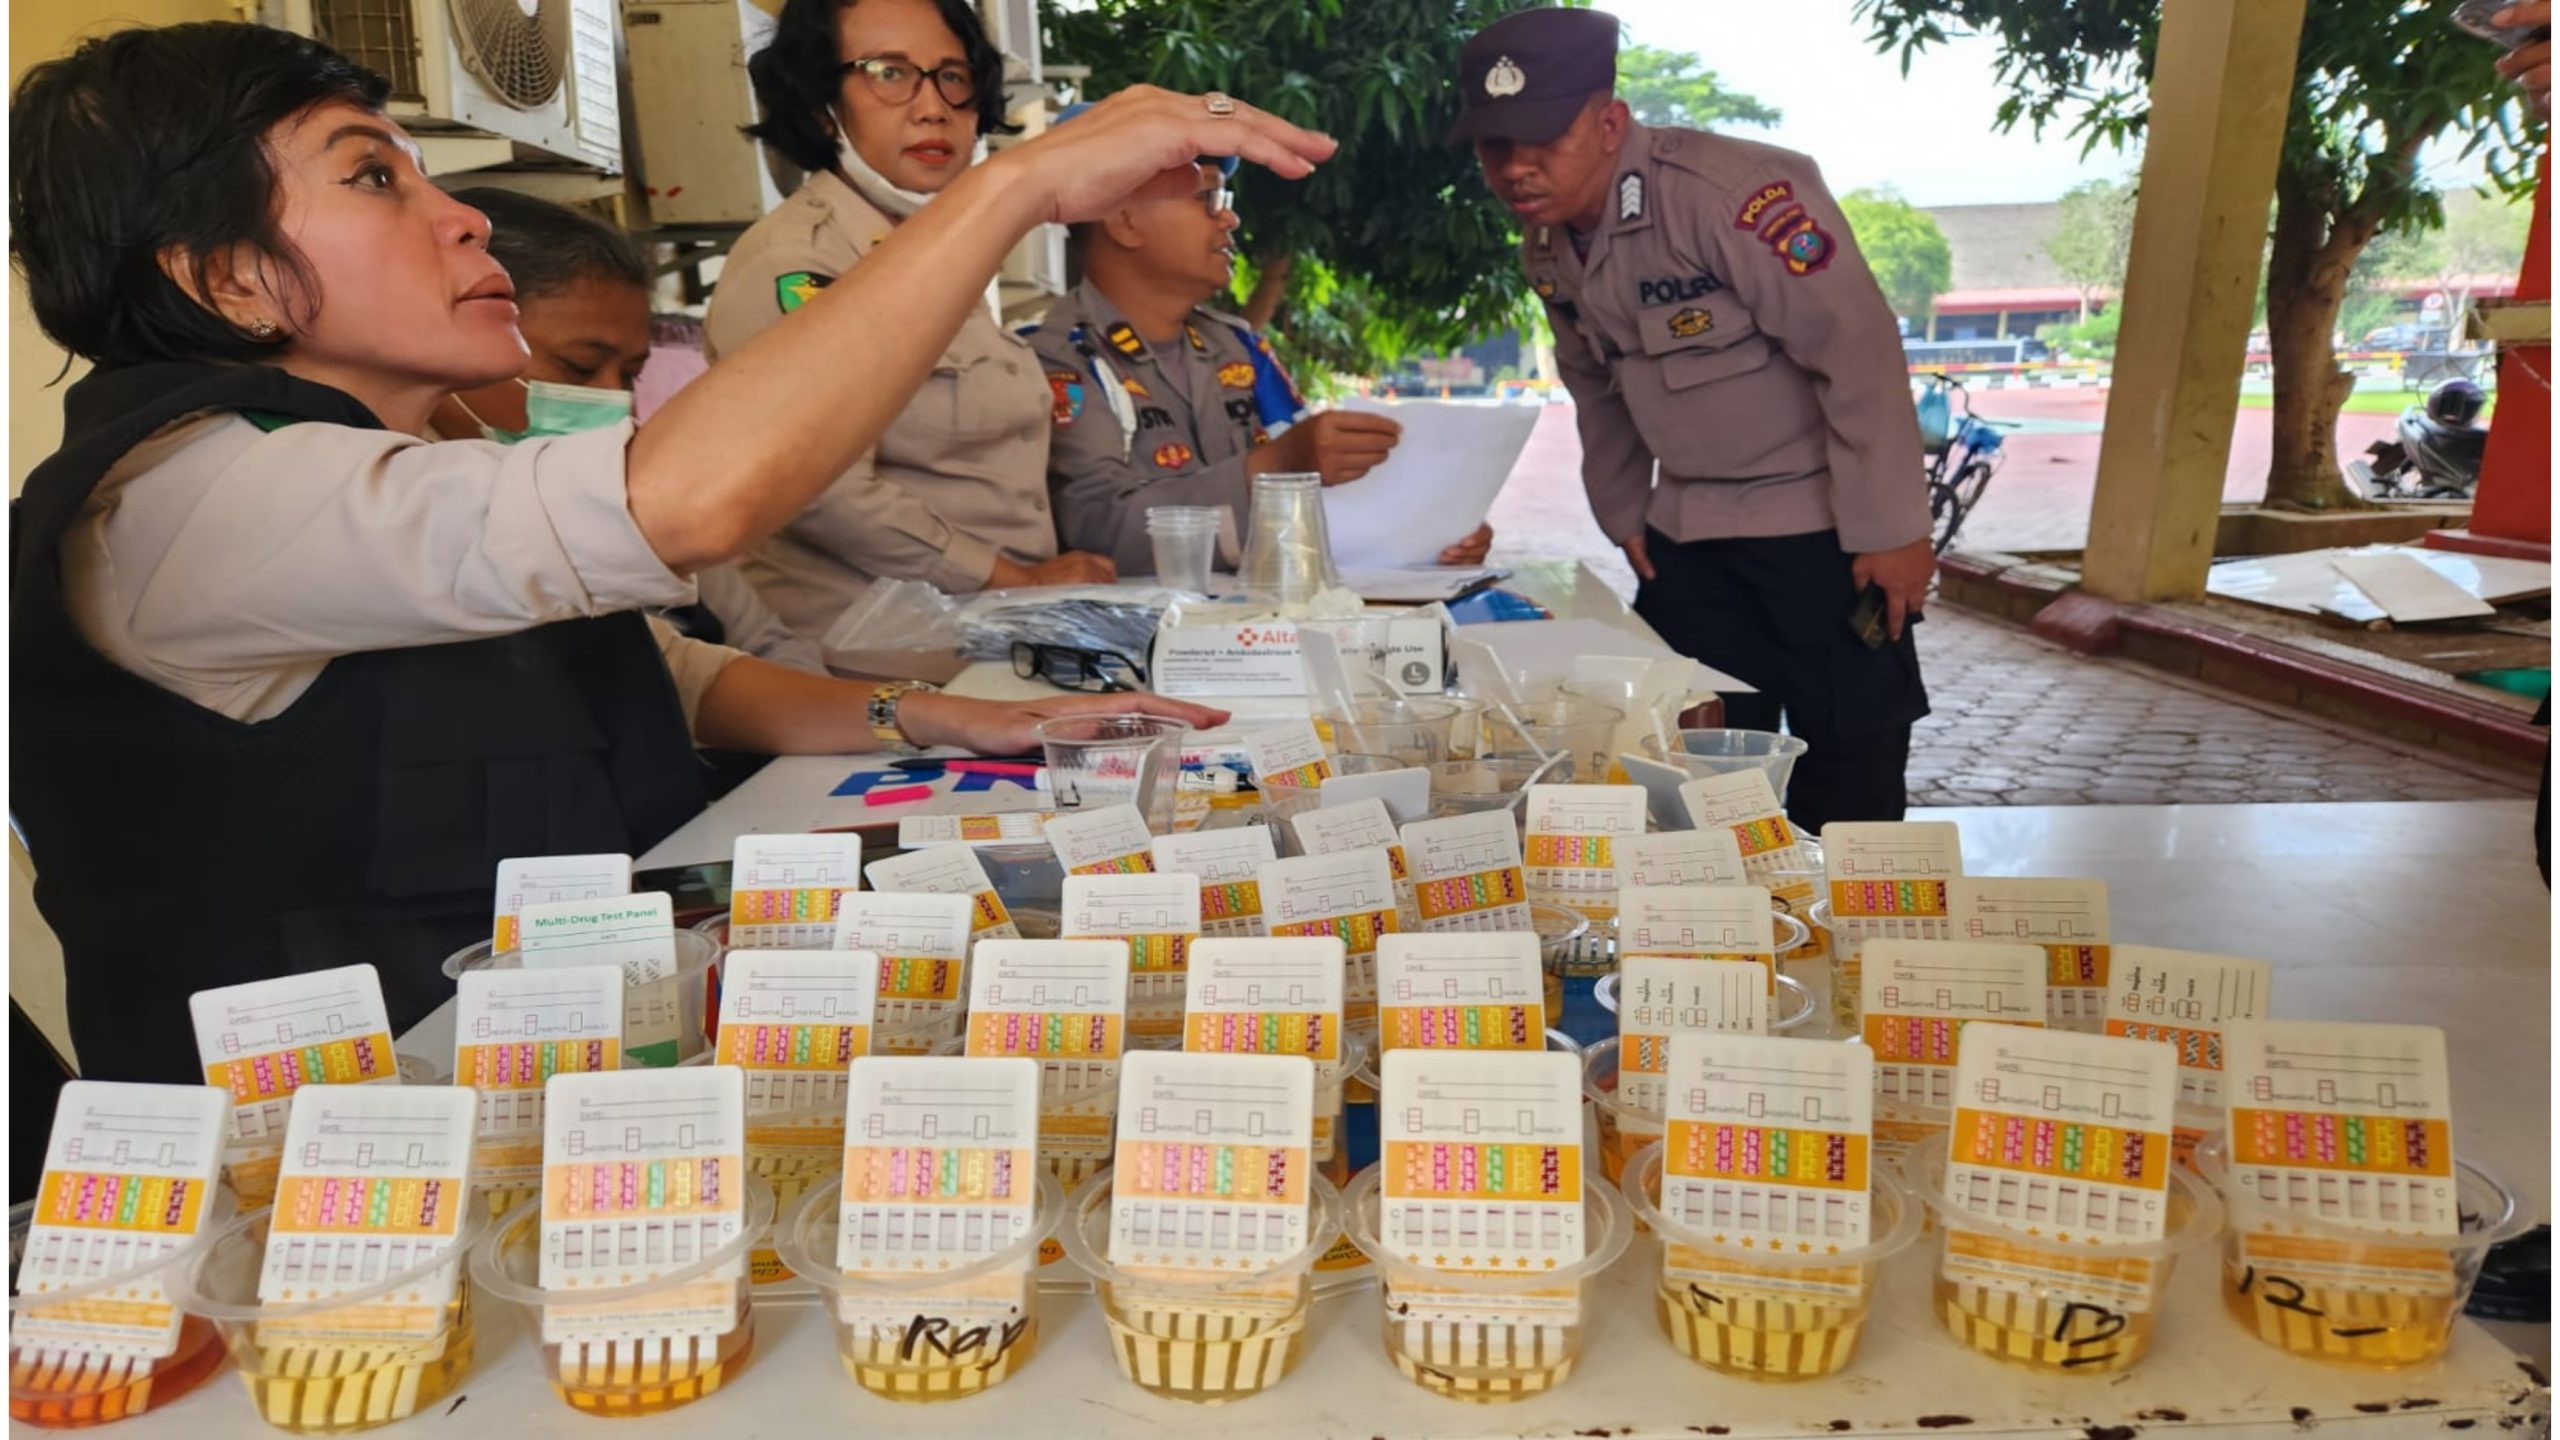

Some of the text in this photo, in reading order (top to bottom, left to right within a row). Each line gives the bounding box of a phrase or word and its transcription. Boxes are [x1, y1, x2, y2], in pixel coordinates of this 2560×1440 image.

[1742, 186, 1788, 223] POLDA
[1411, 664, 1421, 676] L
[535, 908, 658, 928] Multi-Drug Test Panel
